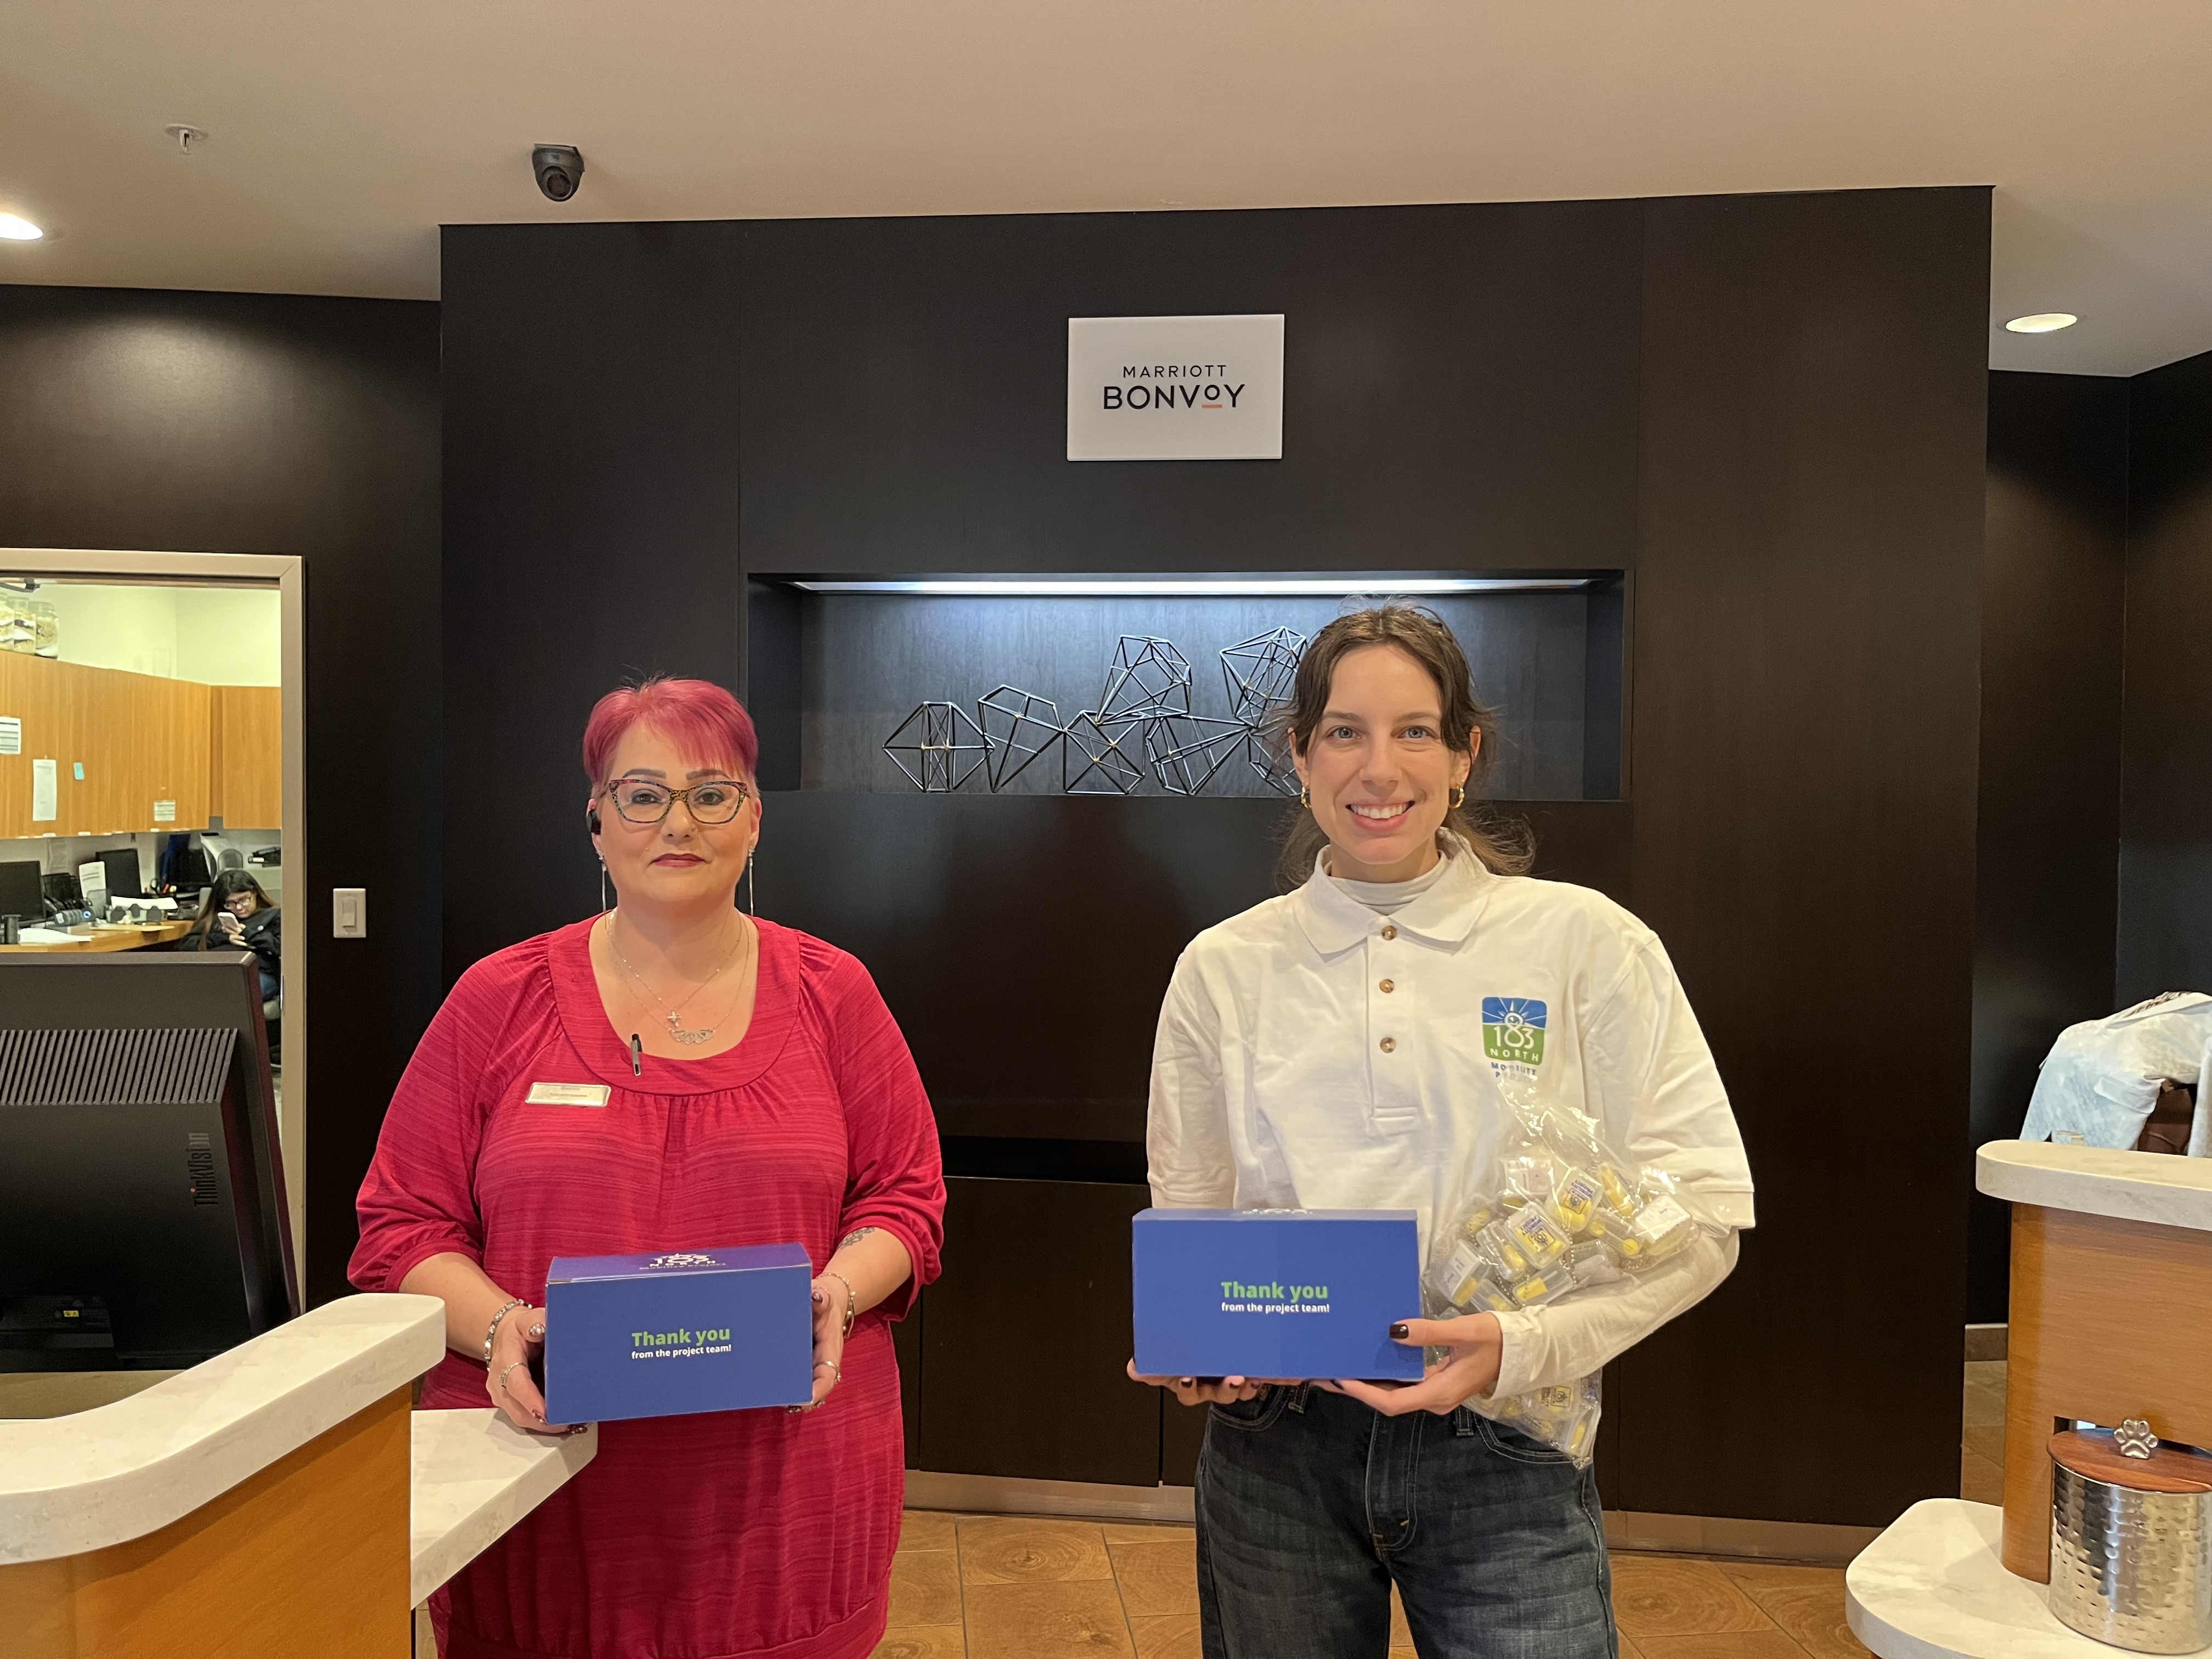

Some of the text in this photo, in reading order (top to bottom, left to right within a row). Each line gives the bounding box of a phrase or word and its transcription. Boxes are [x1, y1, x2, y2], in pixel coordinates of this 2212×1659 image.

[1123, 365, 1227, 378] MARRIOTT
[1103, 383, 1245, 409] BONVOY
[1493, 1012, 1534, 1049] 183
[1490, 1048, 1538, 1062] NORTH
[186, 1132, 219, 1206] ThinkVision
[1221, 1281, 1328, 1304] Thank you
[1221, 1302, 1330, 1314] from the project team!
[631, 1328, 730, 1347] Thank you
[631, 1344, 732, 1359] from the project team!
